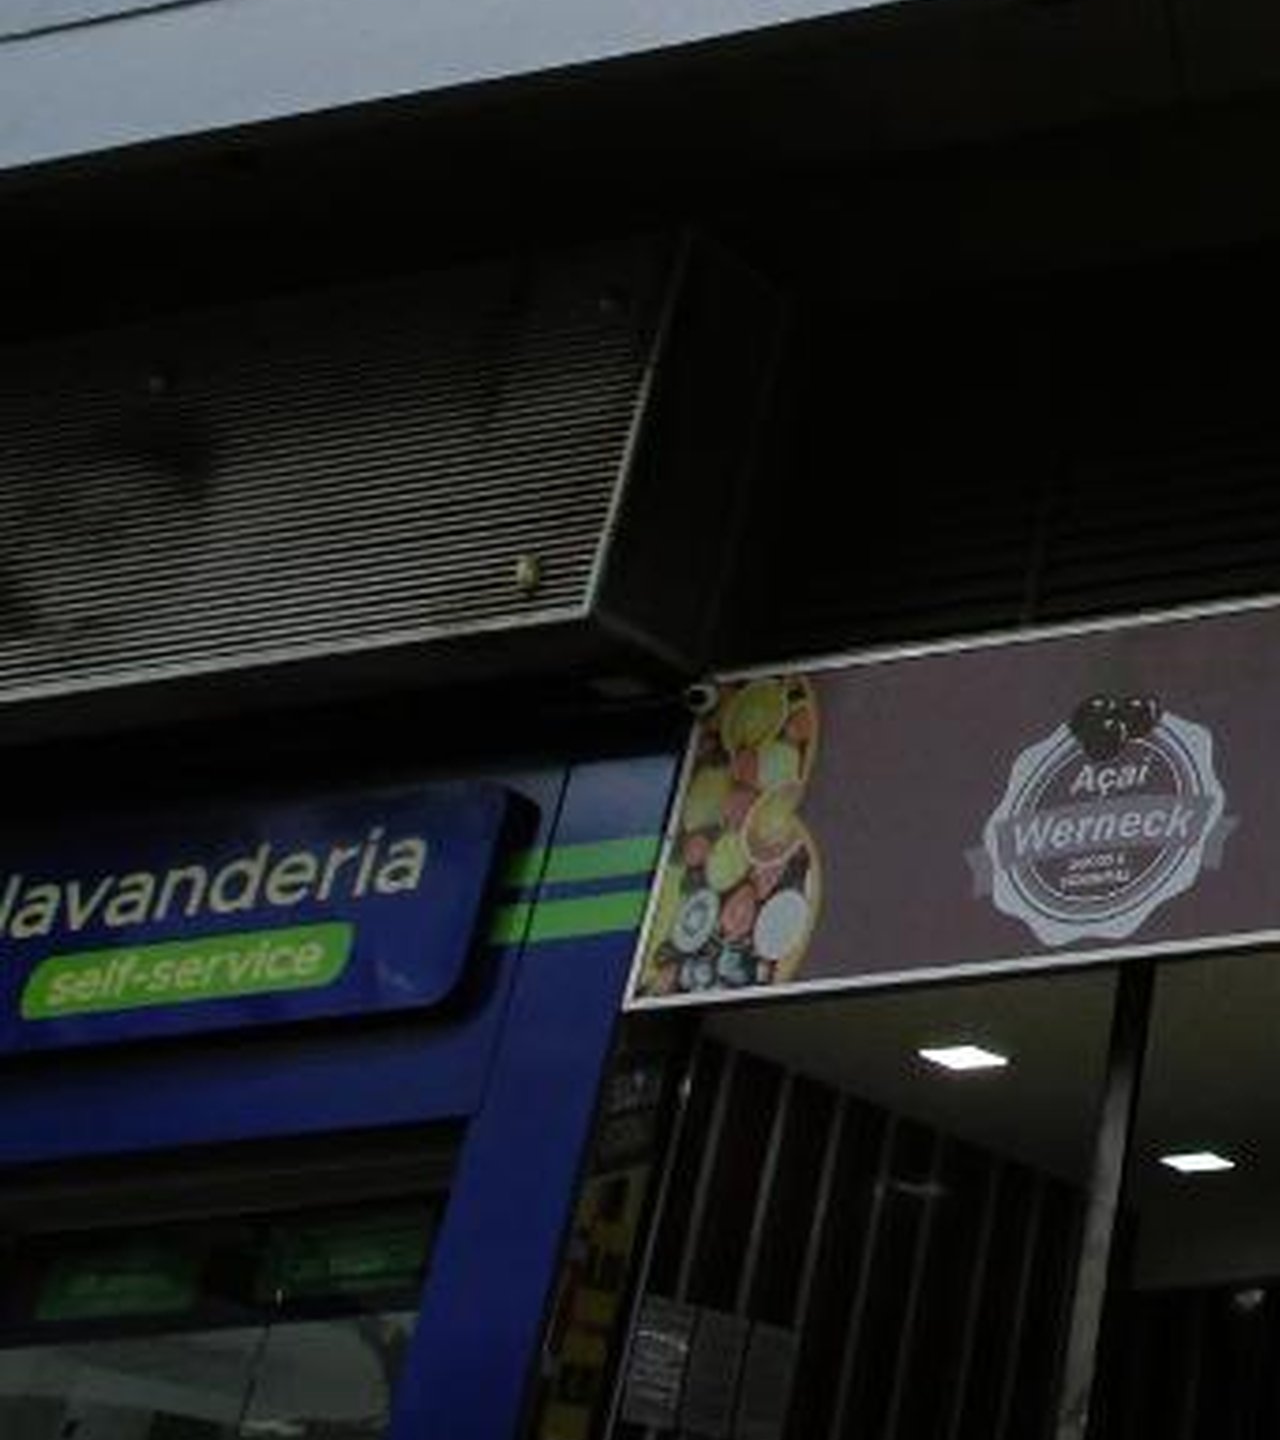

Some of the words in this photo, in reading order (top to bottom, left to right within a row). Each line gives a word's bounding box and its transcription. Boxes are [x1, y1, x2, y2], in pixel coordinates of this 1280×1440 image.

[1013, 805, 1195, 857] Werneck
[0, 826, 427, 940] lavanderia
[45, 939, 325, 1006] self-service
